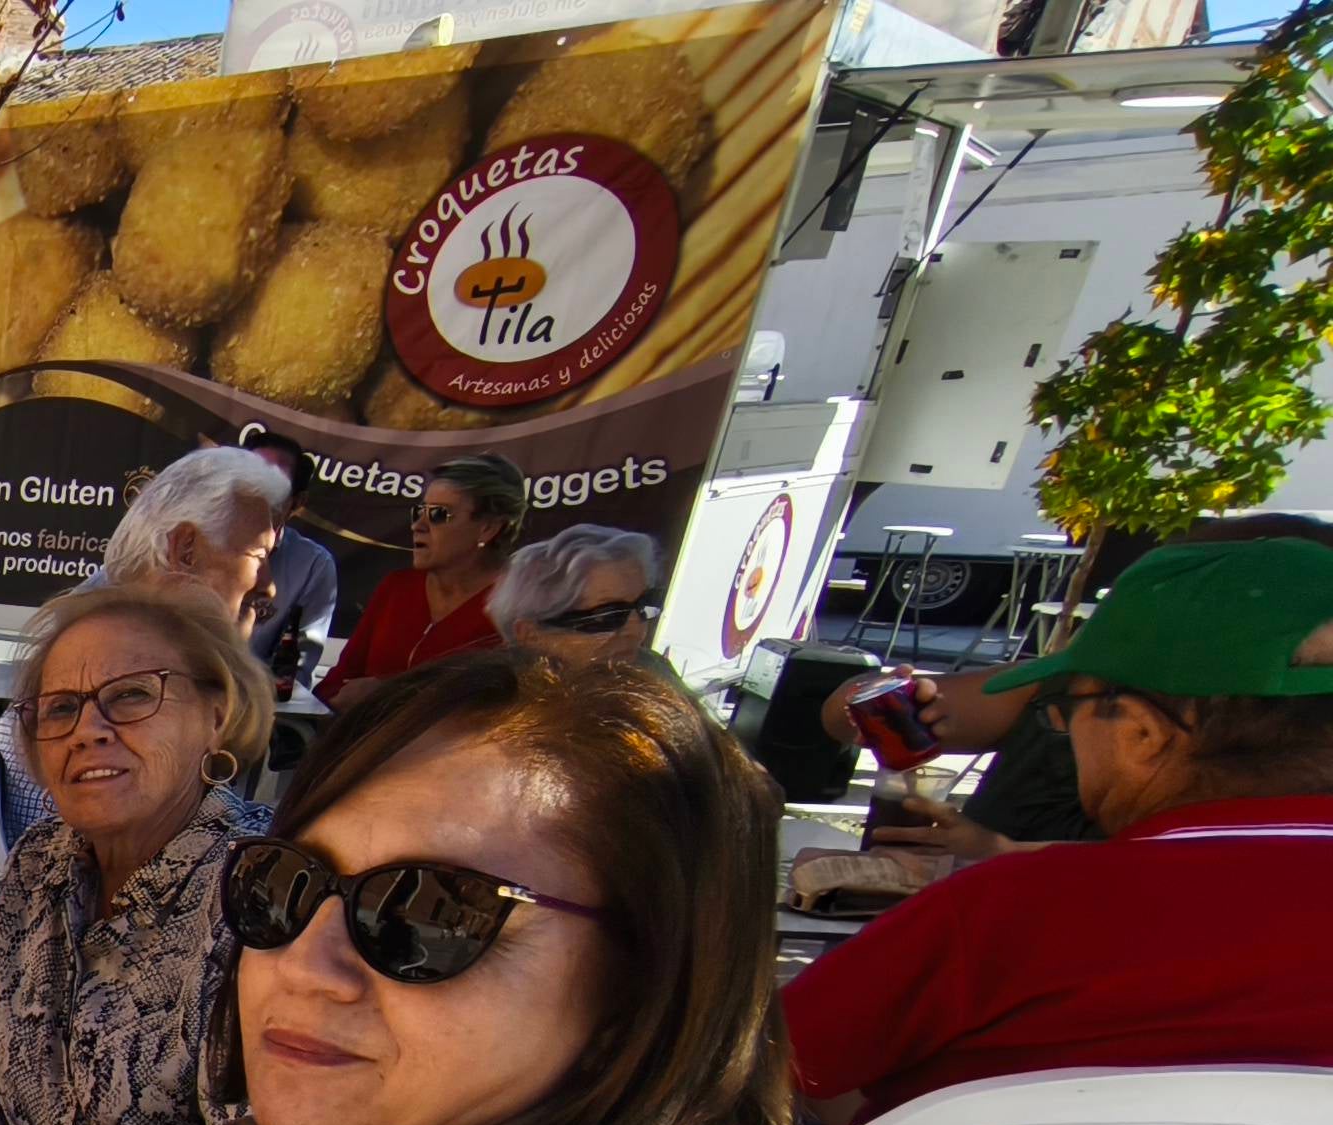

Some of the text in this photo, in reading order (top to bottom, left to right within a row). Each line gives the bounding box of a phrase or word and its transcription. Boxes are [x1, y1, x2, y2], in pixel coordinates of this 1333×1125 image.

[393, 145, 584, 295] Croquetas
[448, 281, 658, 395] Artesanas y deliciosas
[20, 476, 115, 507] Gluten
[239, 422, 667, 509] Cuetas ggets
[2, 554, 105, 577] producto
[37, 528, 110, 553] fabrica
